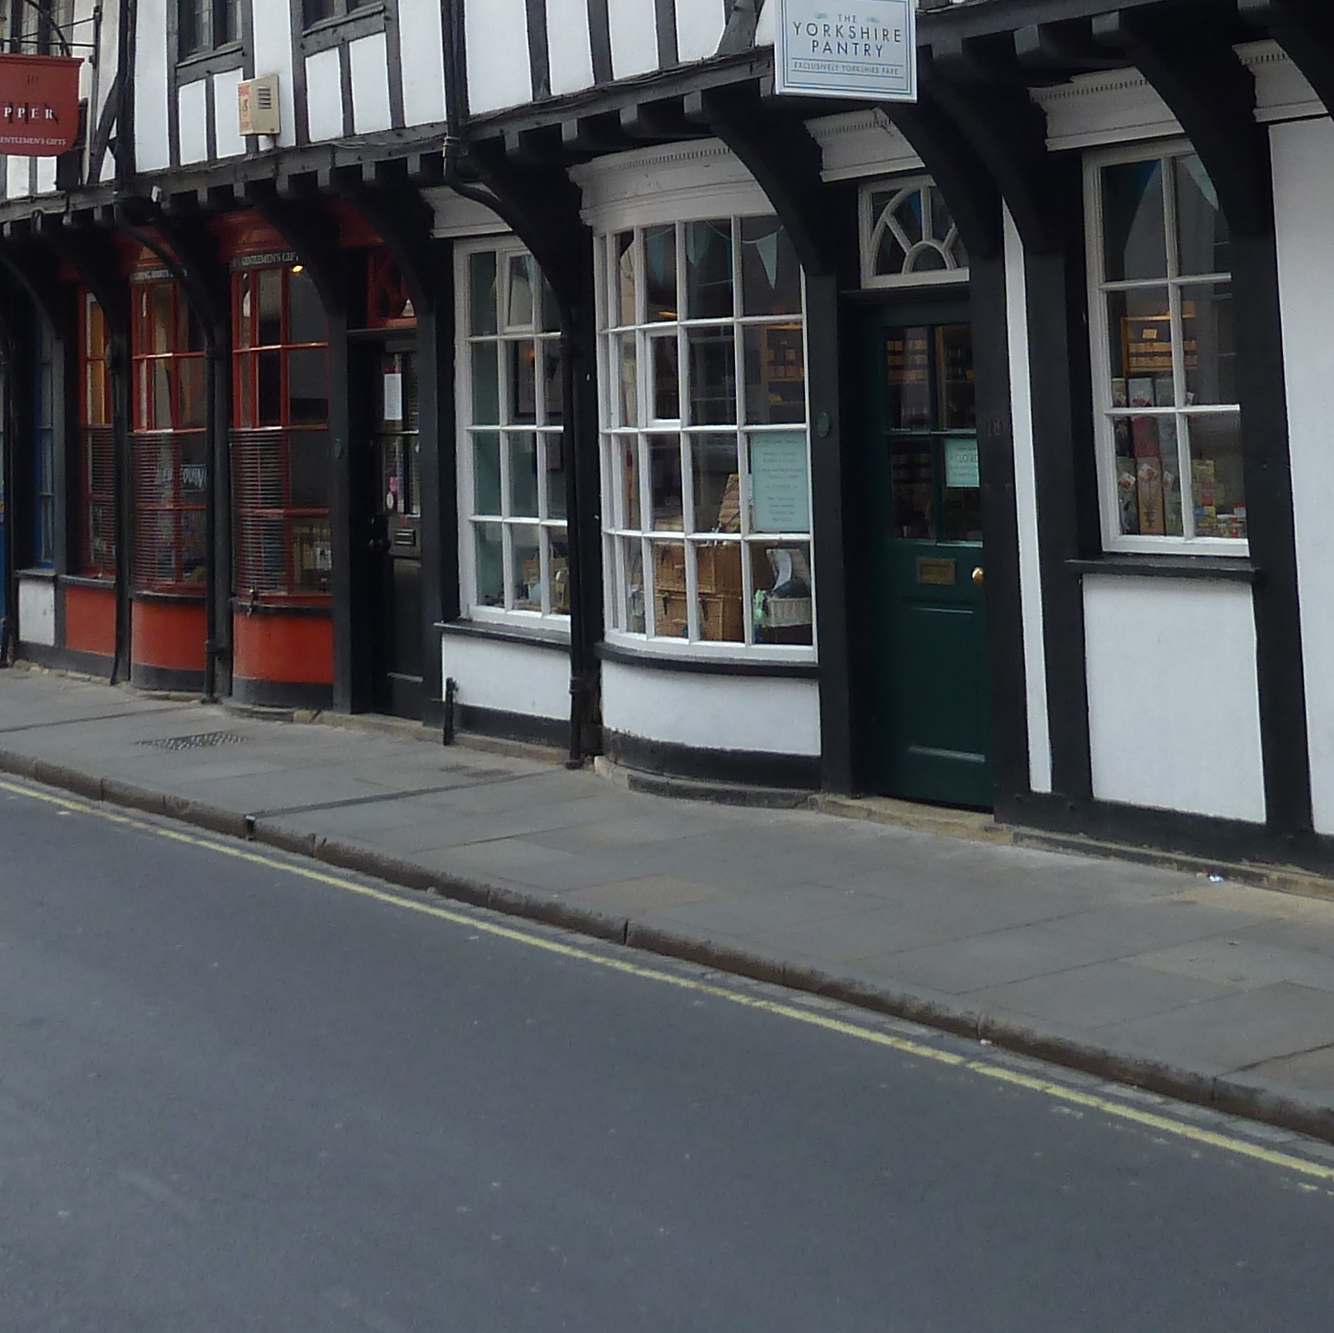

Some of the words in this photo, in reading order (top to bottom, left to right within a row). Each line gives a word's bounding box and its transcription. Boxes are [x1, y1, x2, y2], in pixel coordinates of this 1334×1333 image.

[838, 14, 857, 23] THE
[792, 21, 901, 42] YORKSHIRE
[812, 40, 883, 57] PANTRY
[794, 61, 839, 72] EXCLUSIVELY
